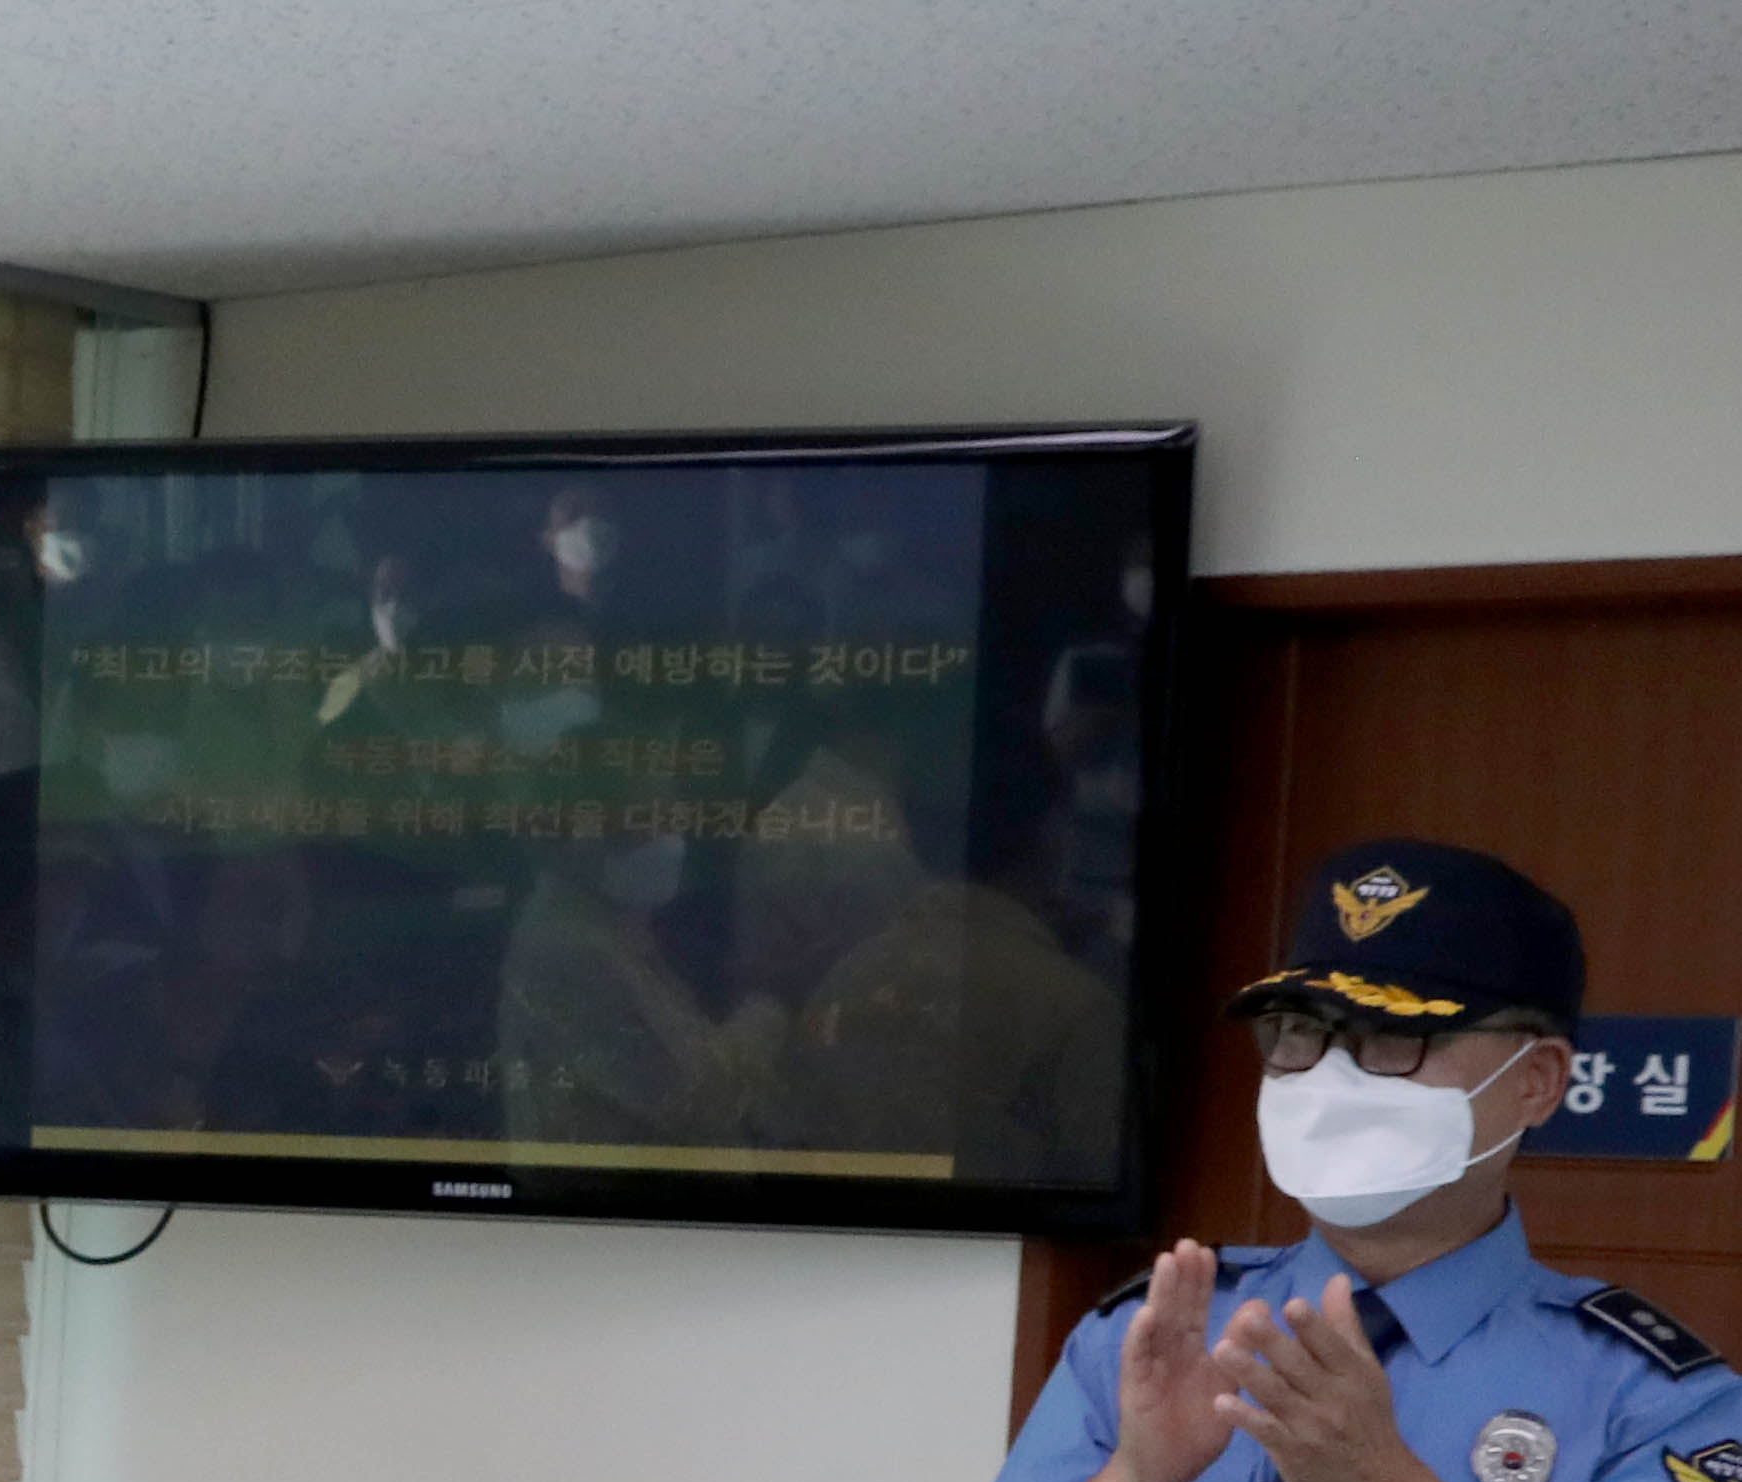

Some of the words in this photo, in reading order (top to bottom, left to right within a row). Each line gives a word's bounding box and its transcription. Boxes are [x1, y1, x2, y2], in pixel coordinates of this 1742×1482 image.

[512, 642, 597, 685] 사전
[613, 641, 794, 686] 예방하는
[389, 798, 467, 837] 위해
[483, 799, 609, 840] 최선을
[432, 1180, 513, 1200] SAMSUNG
